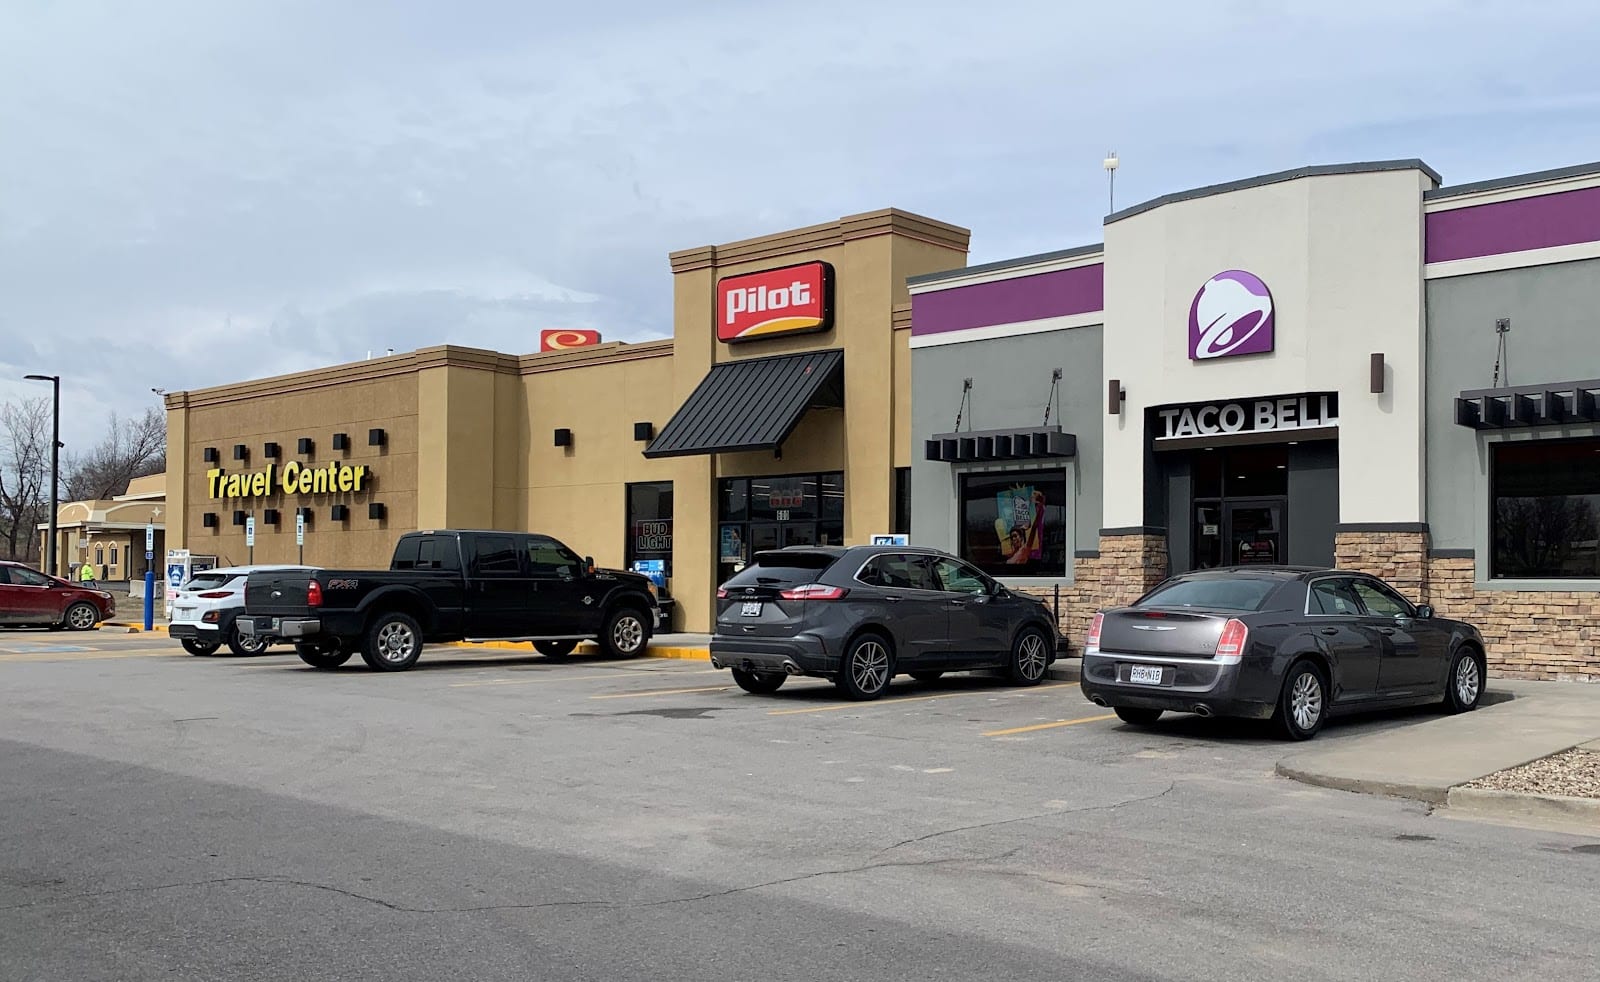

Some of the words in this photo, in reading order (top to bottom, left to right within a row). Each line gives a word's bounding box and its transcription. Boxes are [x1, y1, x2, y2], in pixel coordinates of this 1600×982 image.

[1159, 403, 1246, 437] TACO
[1254, 396, 1339, 431] BELL
[207, 463, 275, 499] Travel
[282, 461, 367, 495] Center
[638, 535, 672, 549] LIGHT
[642, 522, 668, 536] BUD
